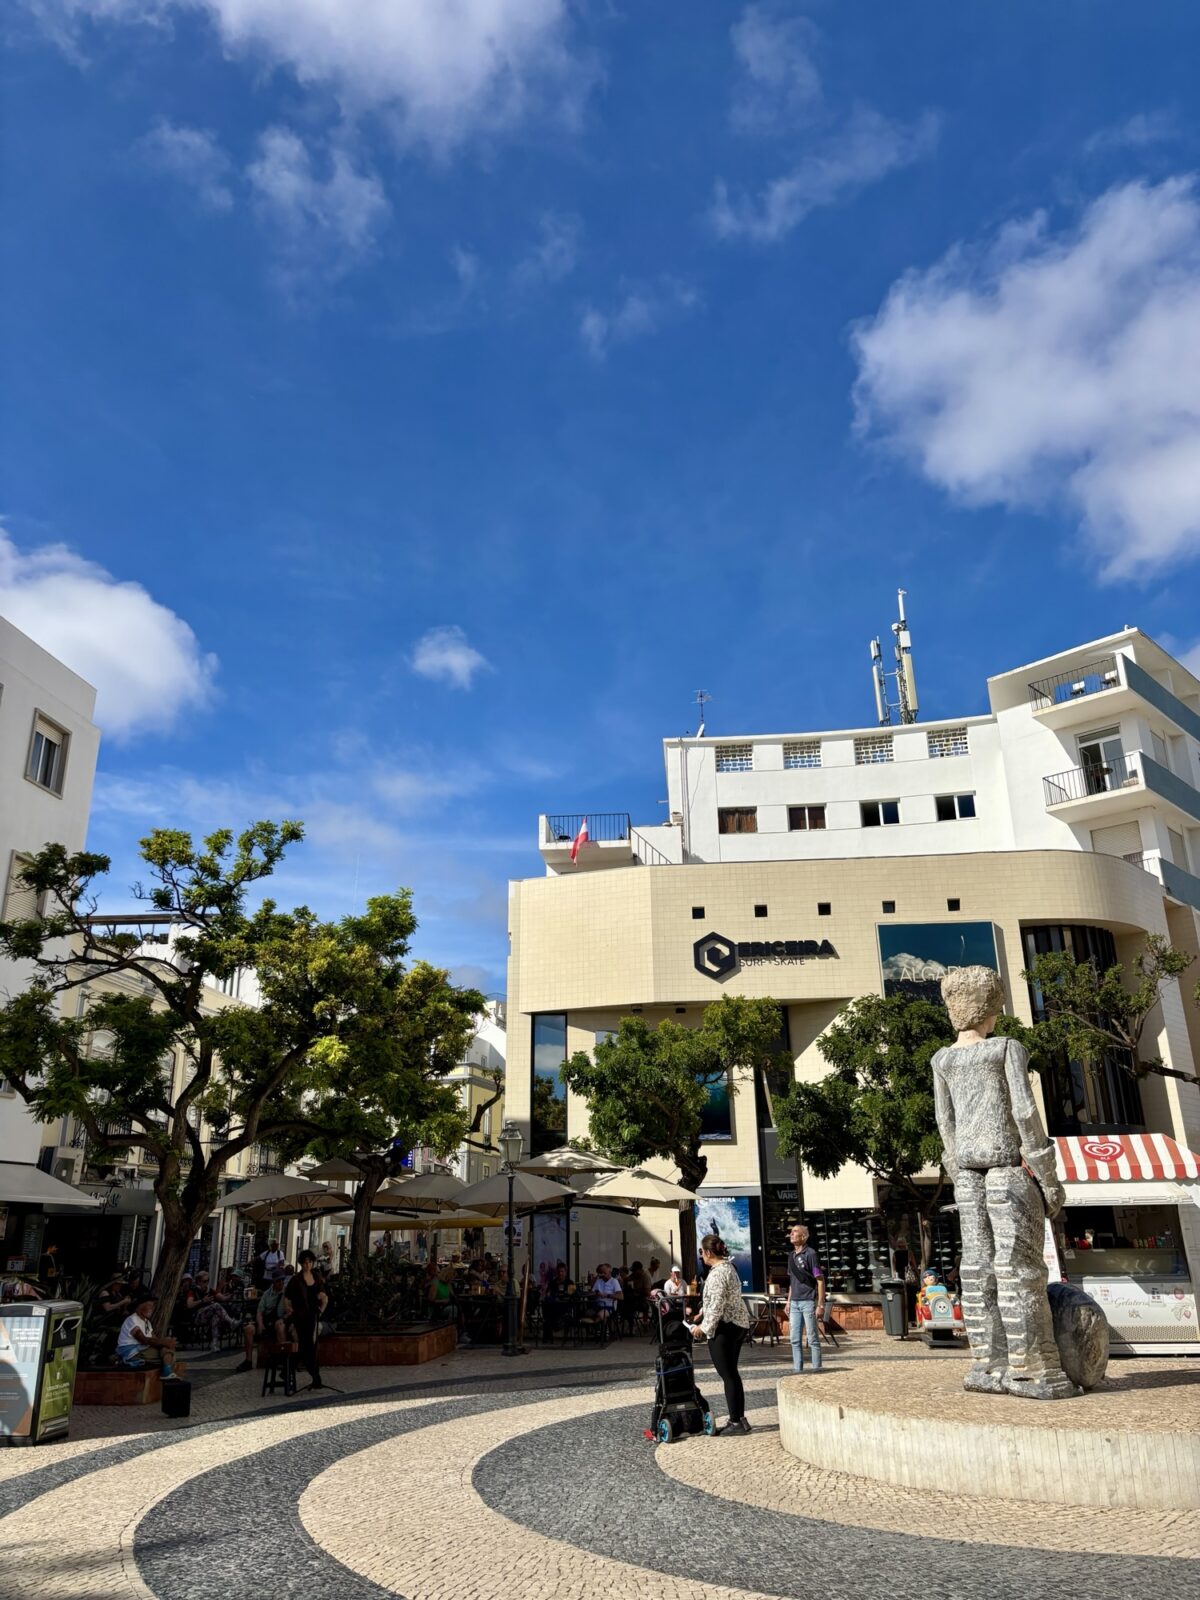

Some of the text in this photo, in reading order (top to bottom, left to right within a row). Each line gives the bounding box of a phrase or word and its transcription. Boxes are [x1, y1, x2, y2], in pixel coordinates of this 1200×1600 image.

[738, 939, 835, 957] ERICEIRA
[739, 958, 766, 967] SURF
[774, 957, 806, 966] SKATE
[776, 1189, 798, 1200] VANS
